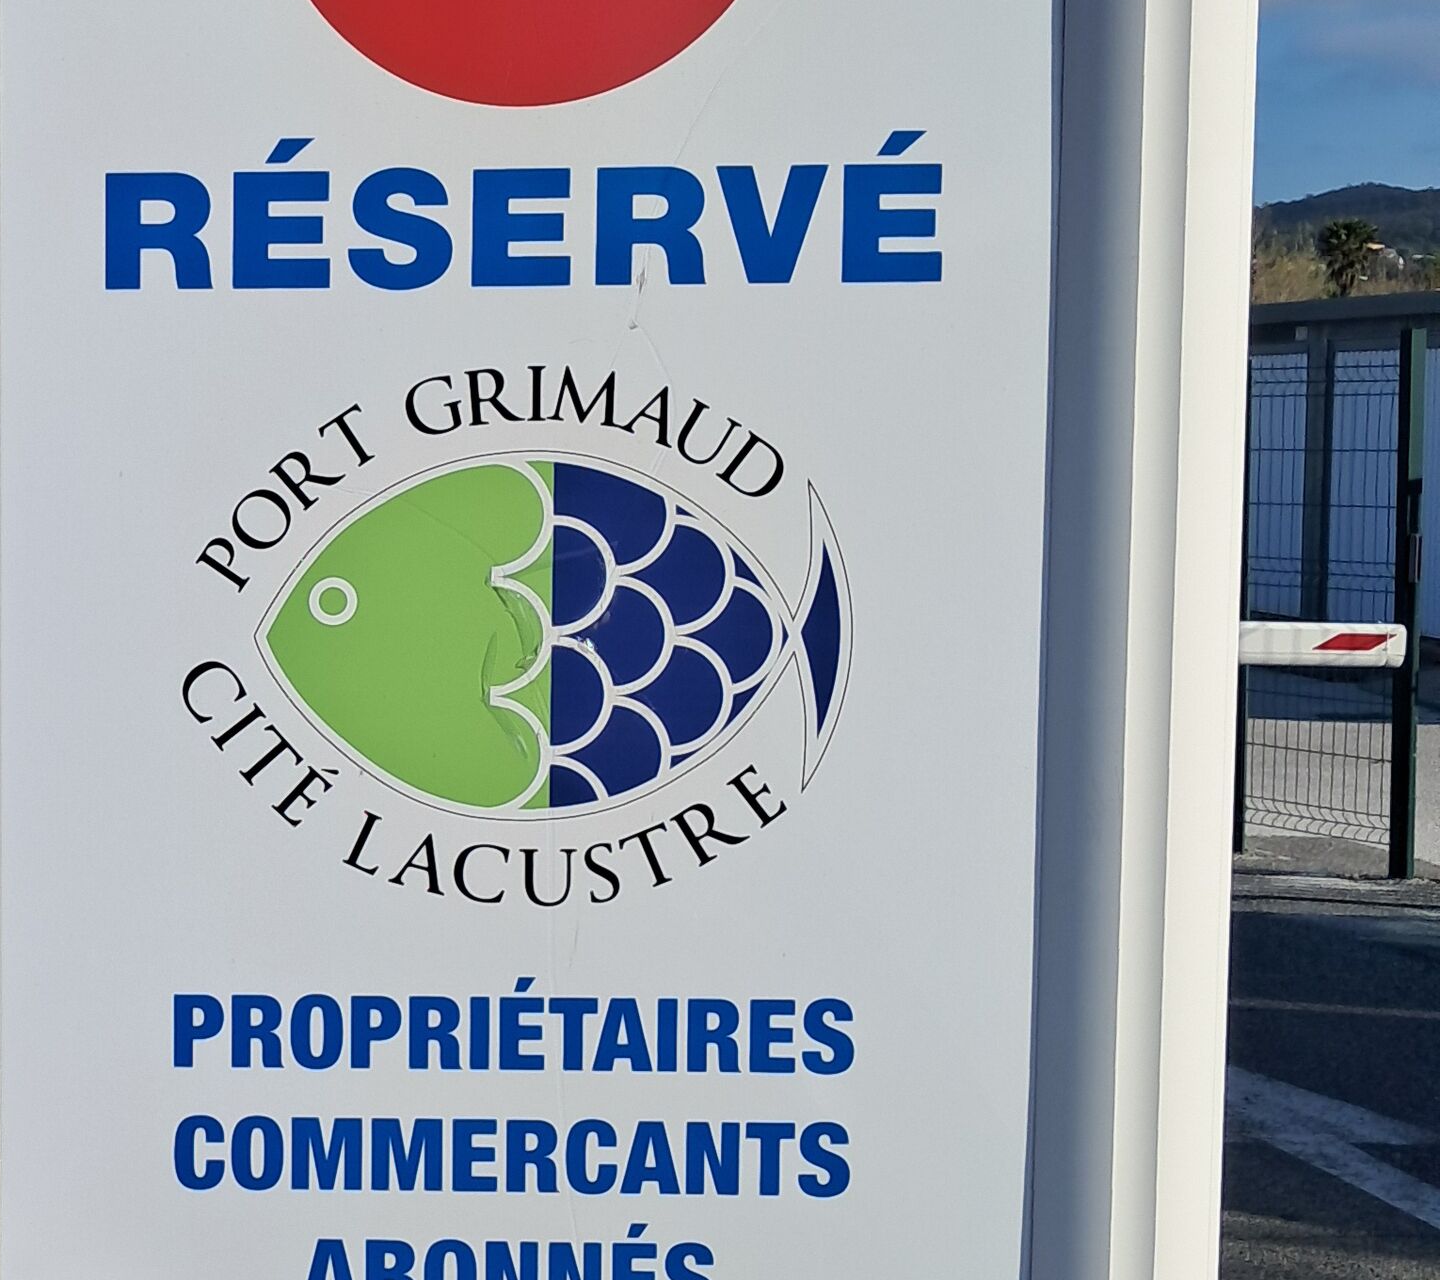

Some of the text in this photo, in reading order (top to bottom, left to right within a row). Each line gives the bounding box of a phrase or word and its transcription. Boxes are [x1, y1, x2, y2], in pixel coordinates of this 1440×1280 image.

[105, 131, 942, 291] RÉSERVÉ
[196, 365, 784, 592] PORT GRIMAUD
[181, 661, 787, 907] CITÉ LACUSTRE
[173, 977, 854, 1075] PROPRIÉTAIRES
[174, 1115, 850, 1198] COMMERCANTS
